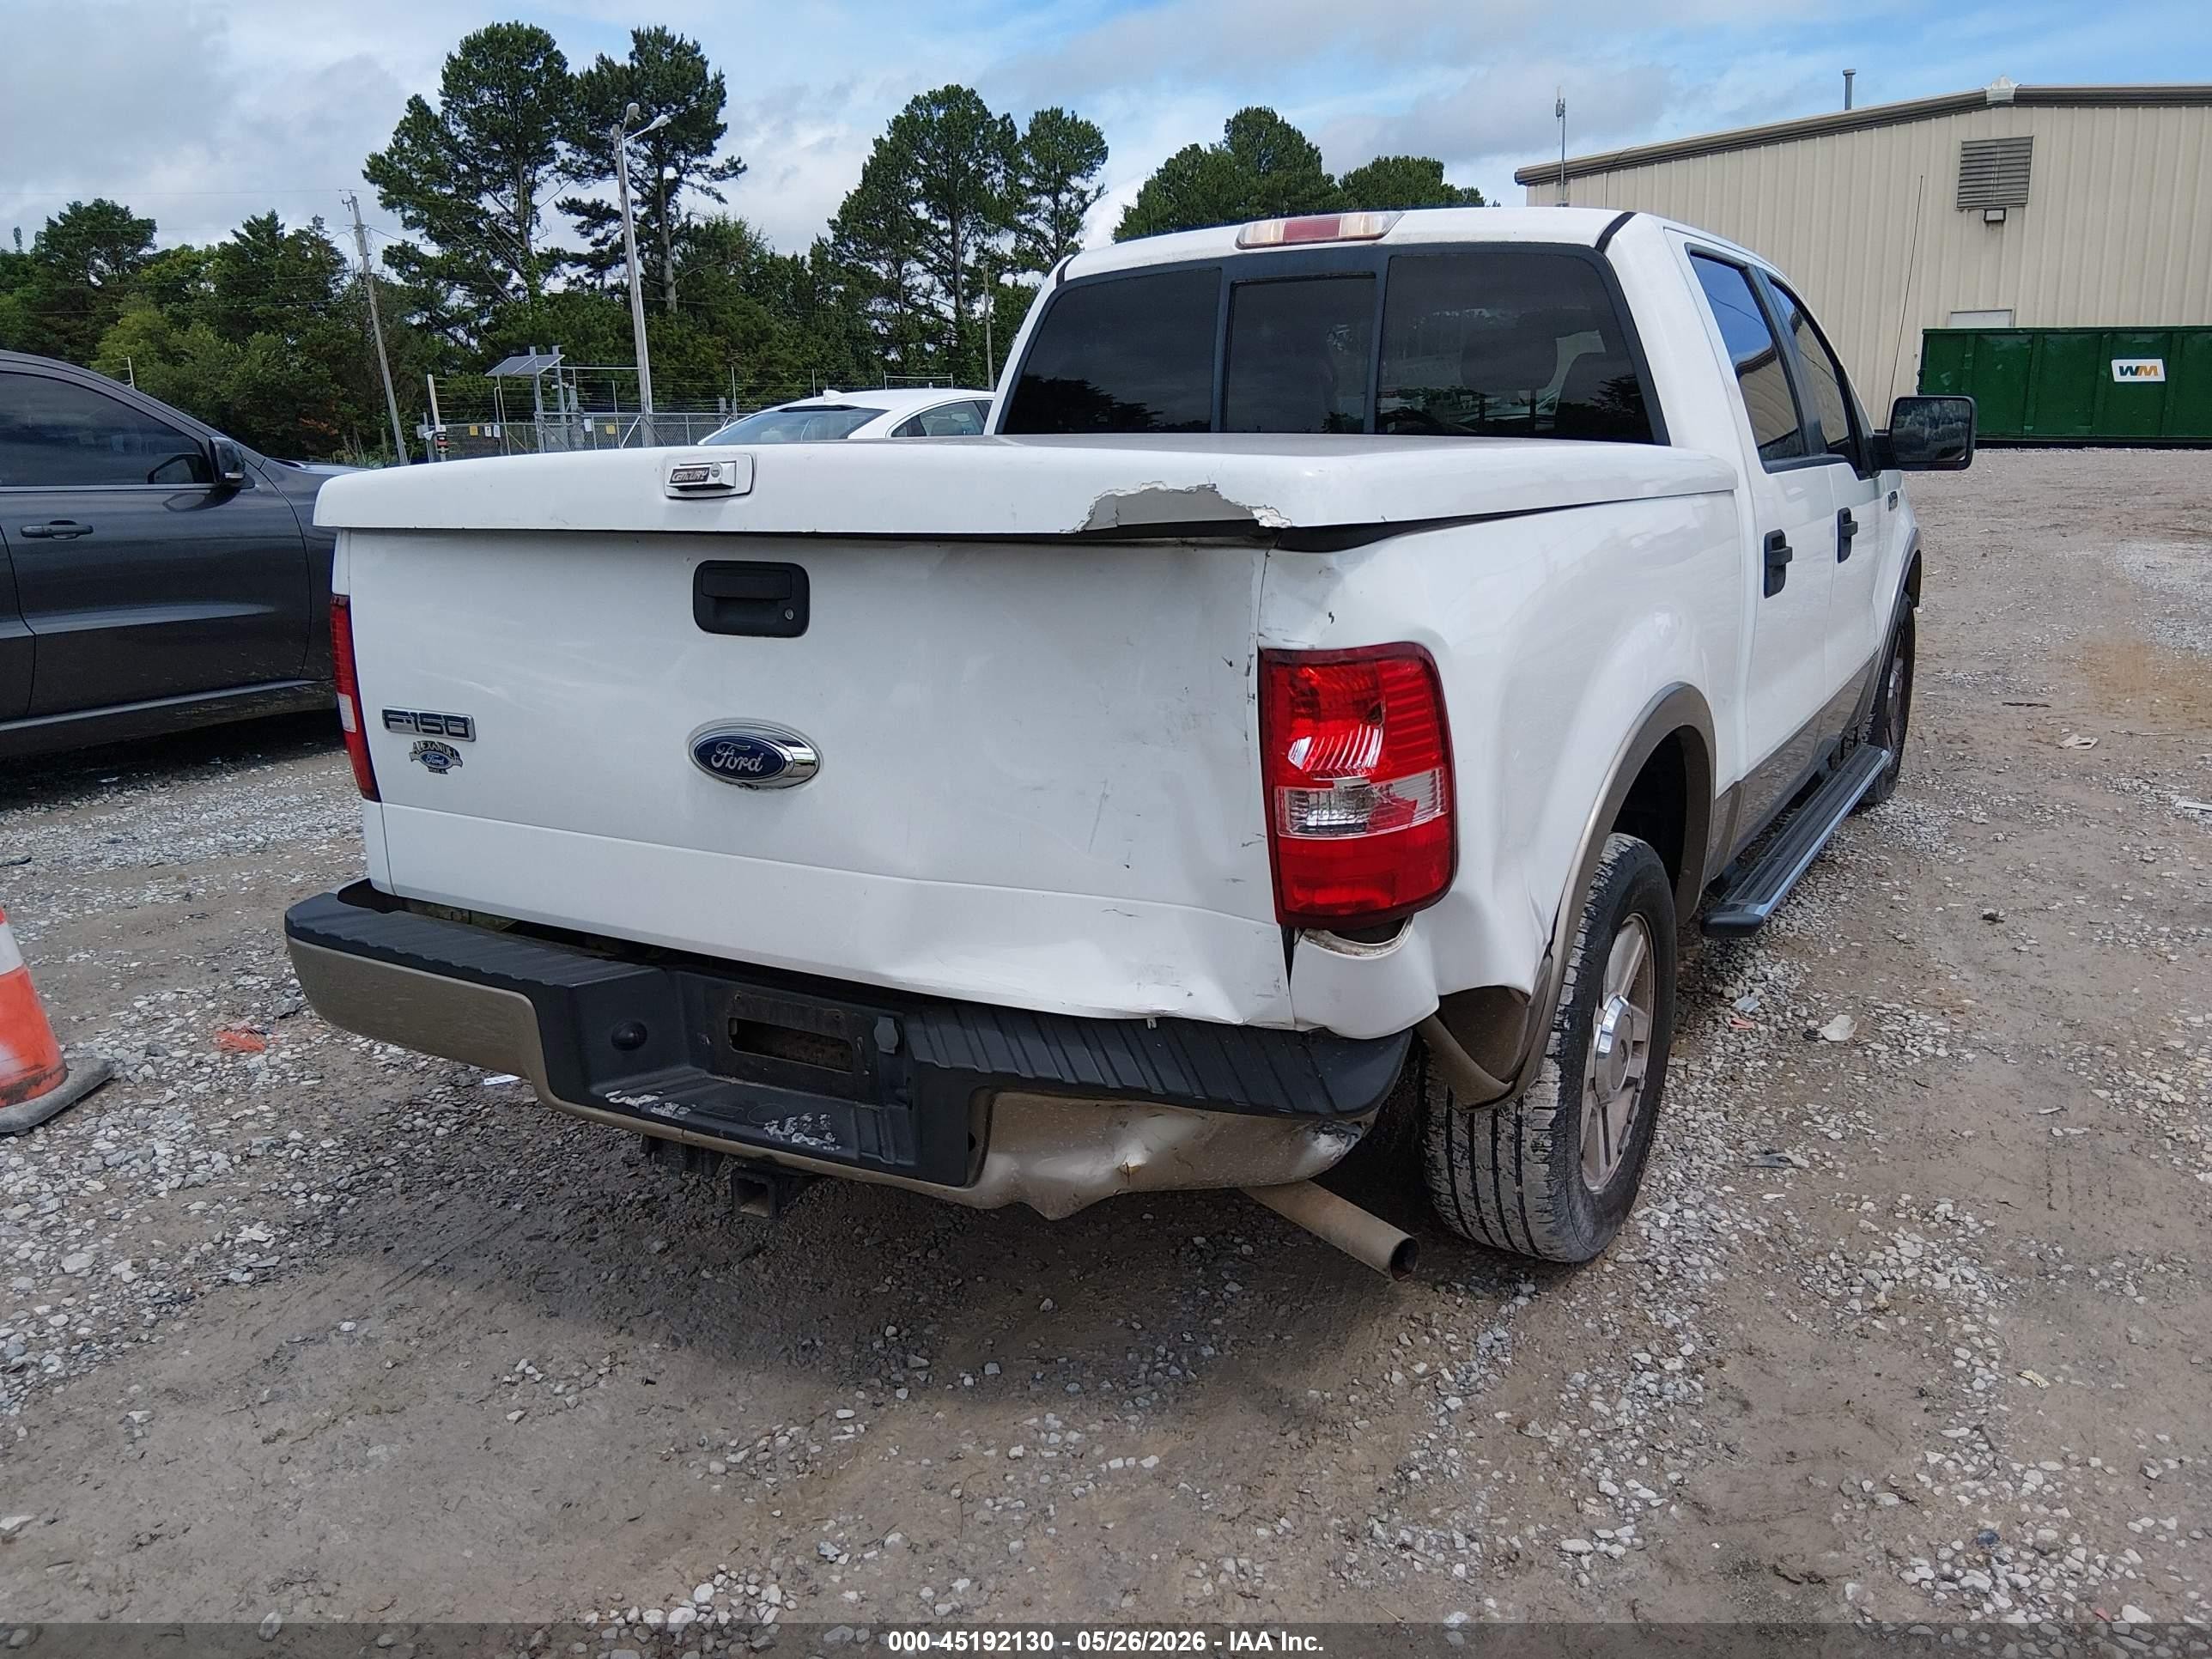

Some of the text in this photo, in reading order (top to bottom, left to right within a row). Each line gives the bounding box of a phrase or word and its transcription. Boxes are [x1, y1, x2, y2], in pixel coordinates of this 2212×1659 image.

[2118, 365, 2158, 376] WM
[382, 709, 469, 738] F-150
[426, 754, 445, 765] Ford
[710, 741, 764, 773] Ford
